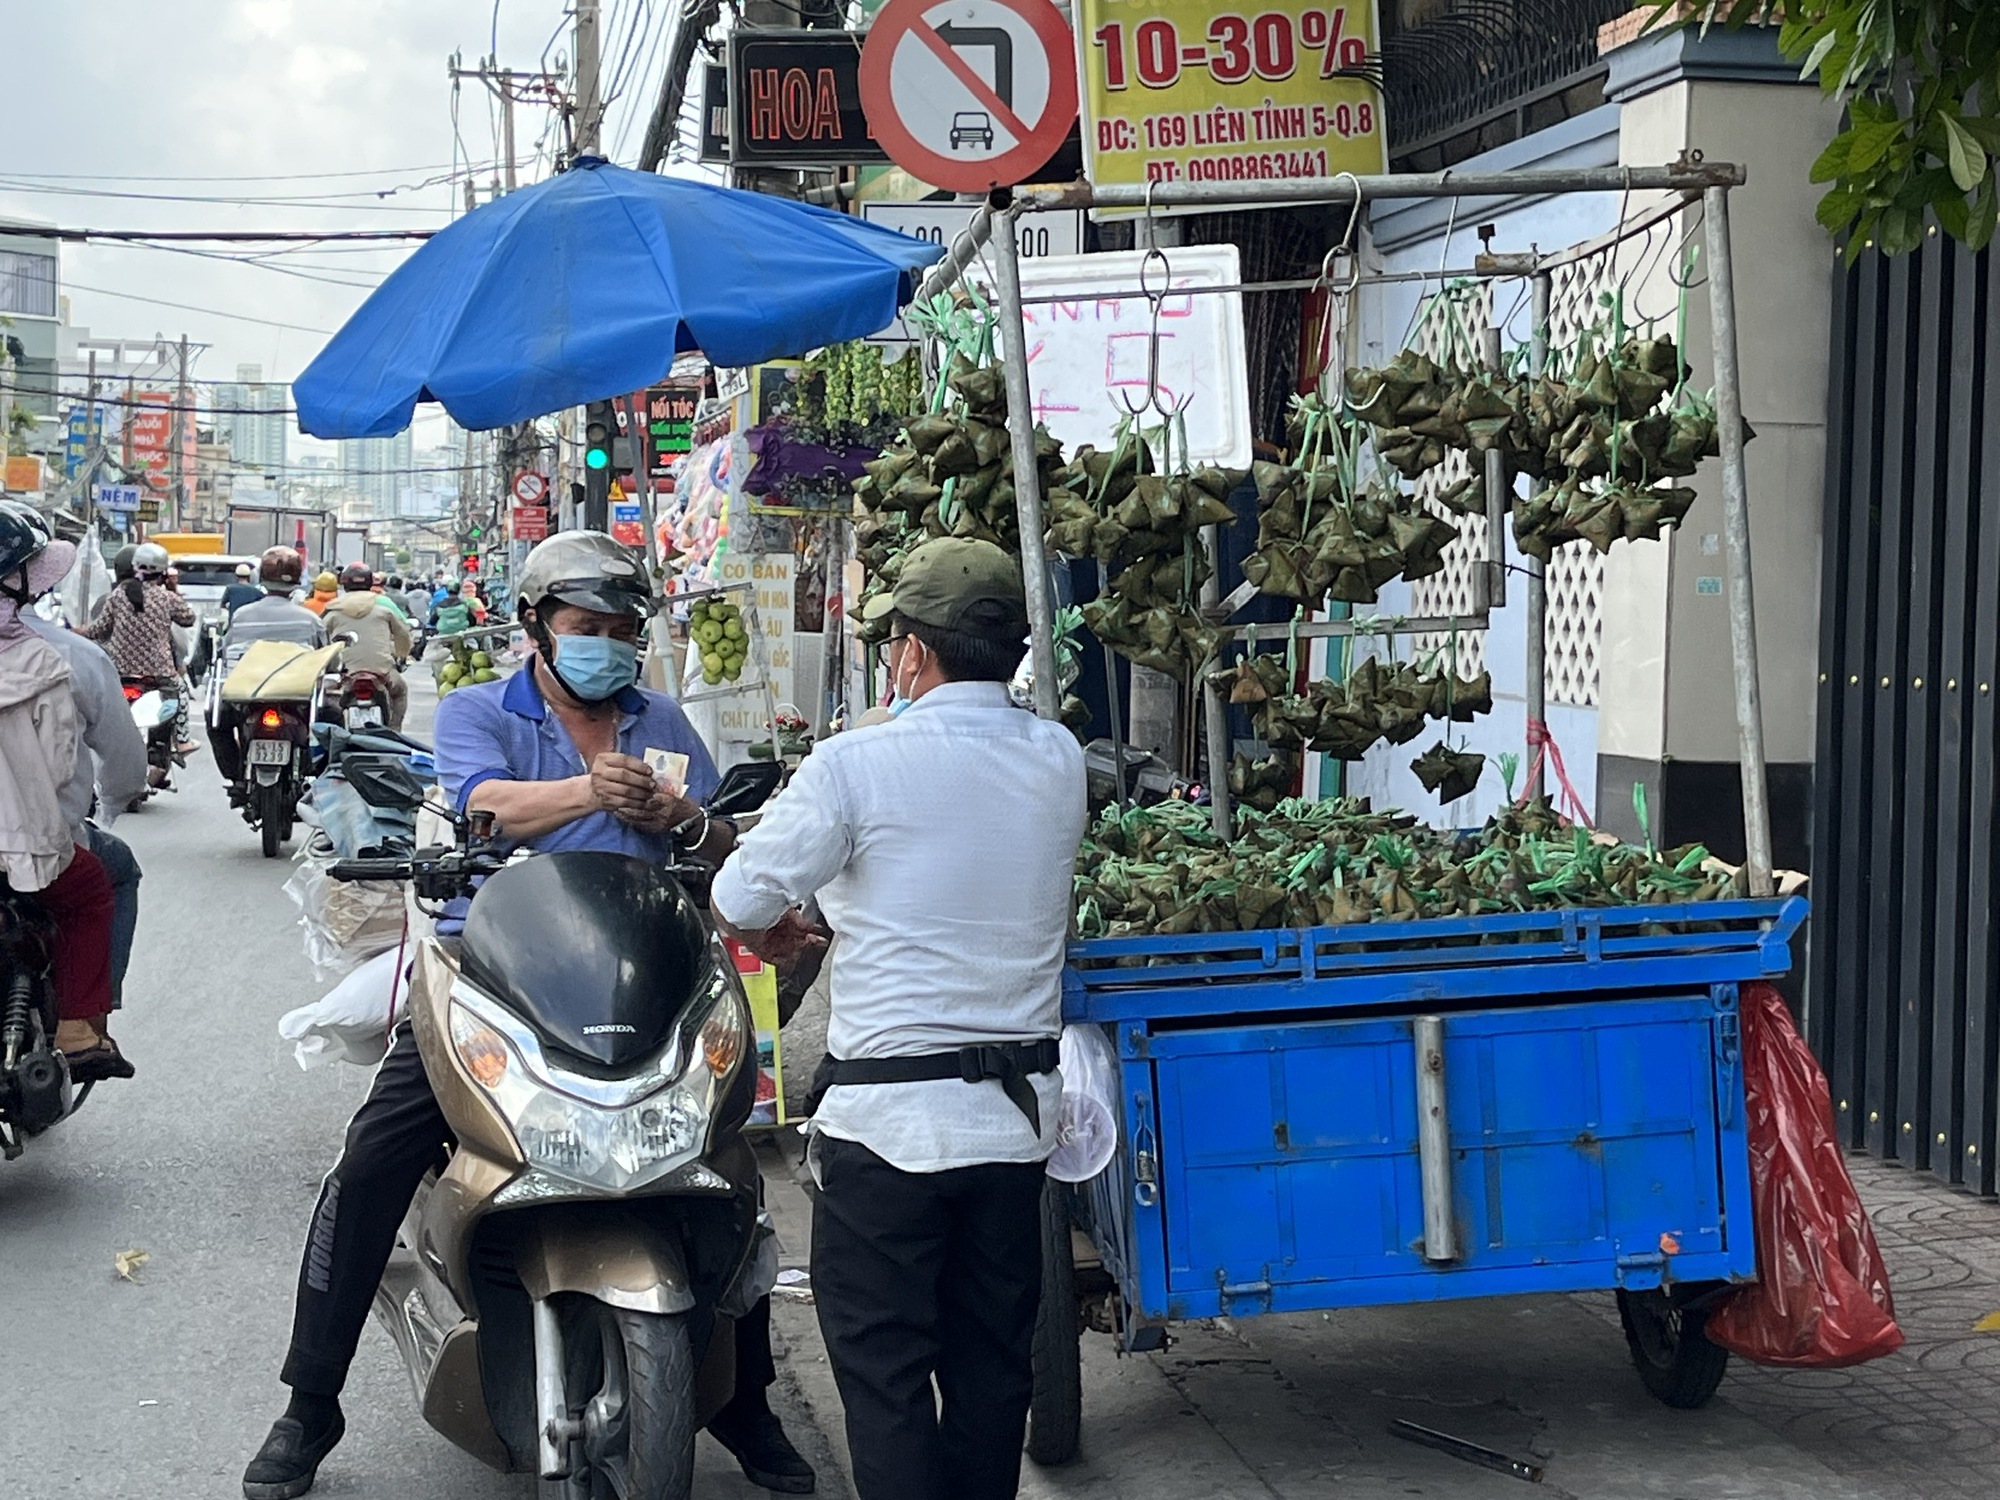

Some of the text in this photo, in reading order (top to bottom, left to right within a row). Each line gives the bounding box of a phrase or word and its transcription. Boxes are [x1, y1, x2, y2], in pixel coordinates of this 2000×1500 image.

[1094, 8, 1366, 88] 10-30%
[750, 68, 843, 140] HOA
[1097, 98, 1373, 151] ĐC: 169 LIÊN TỈNH 5-Q.8
[101, 488, 137, 507] NỆM
[723, 560, 787, 579] CÓ BÁN
[582, 1024, 637, 1035] HONDA
